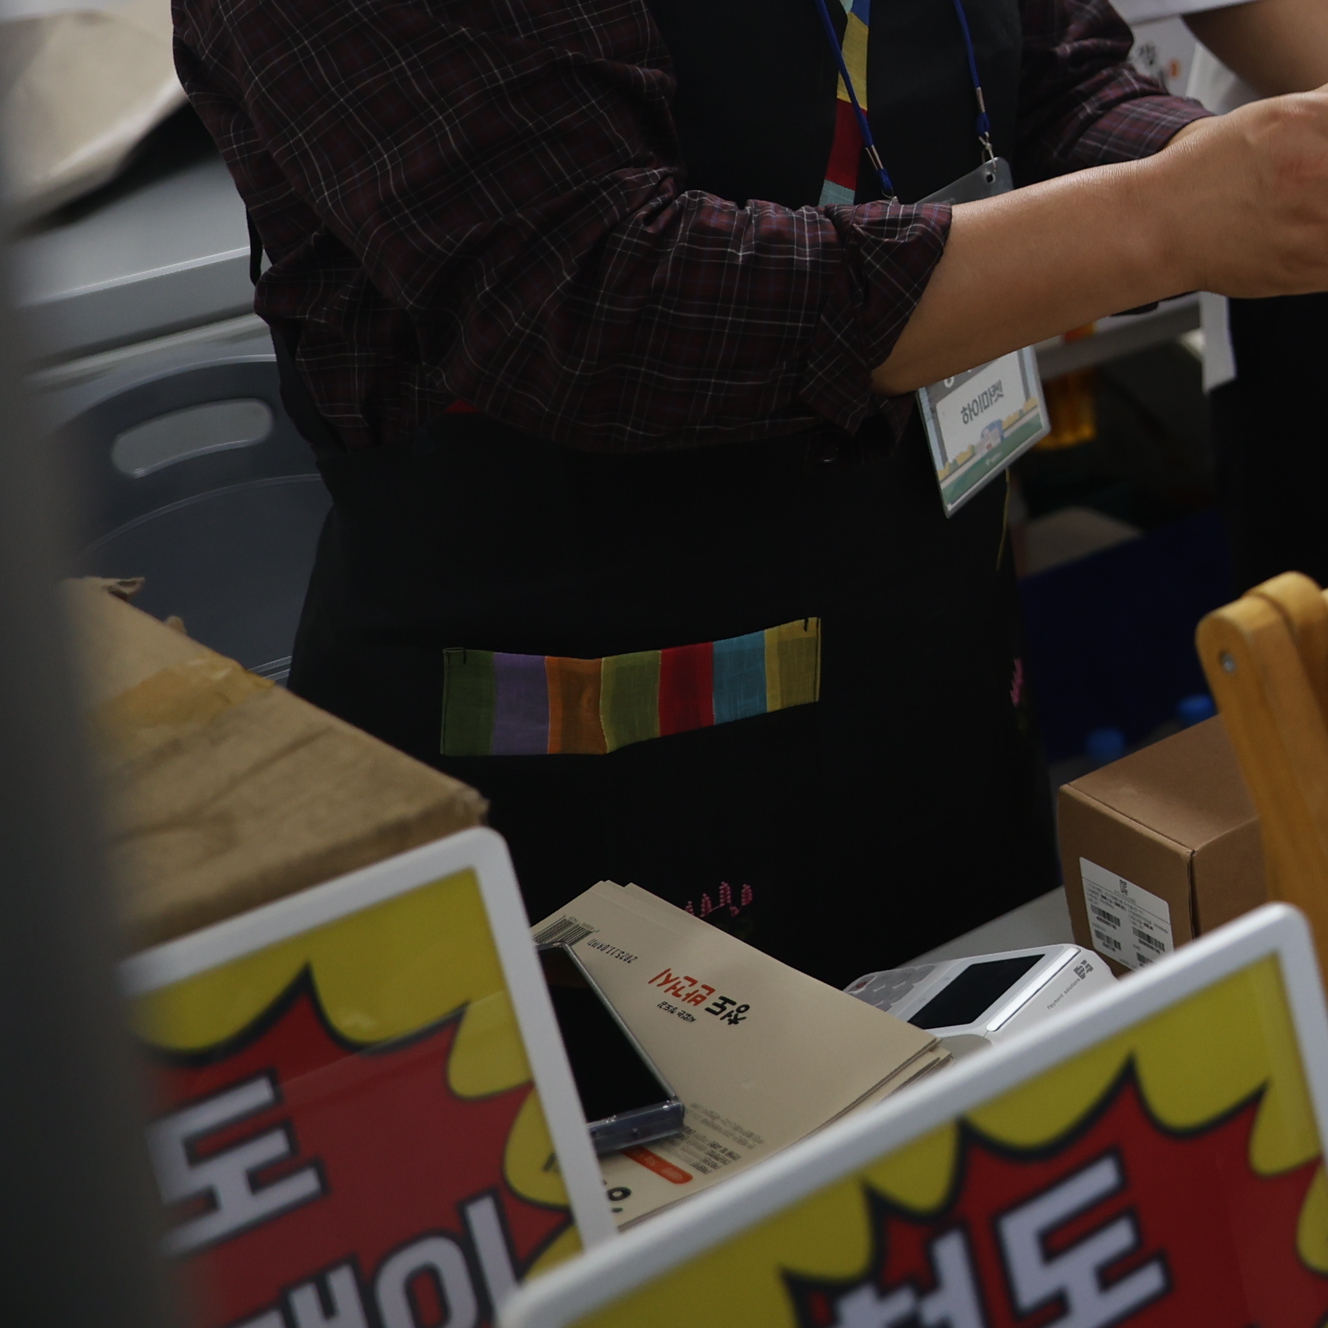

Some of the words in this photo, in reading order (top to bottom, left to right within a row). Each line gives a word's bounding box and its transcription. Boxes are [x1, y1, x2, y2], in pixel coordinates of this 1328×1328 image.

[961, 379, 1004, 425] 하이마켓
[648, 968, 716, 1007] 반건시
[704, 994, 751, 1026] 청도
